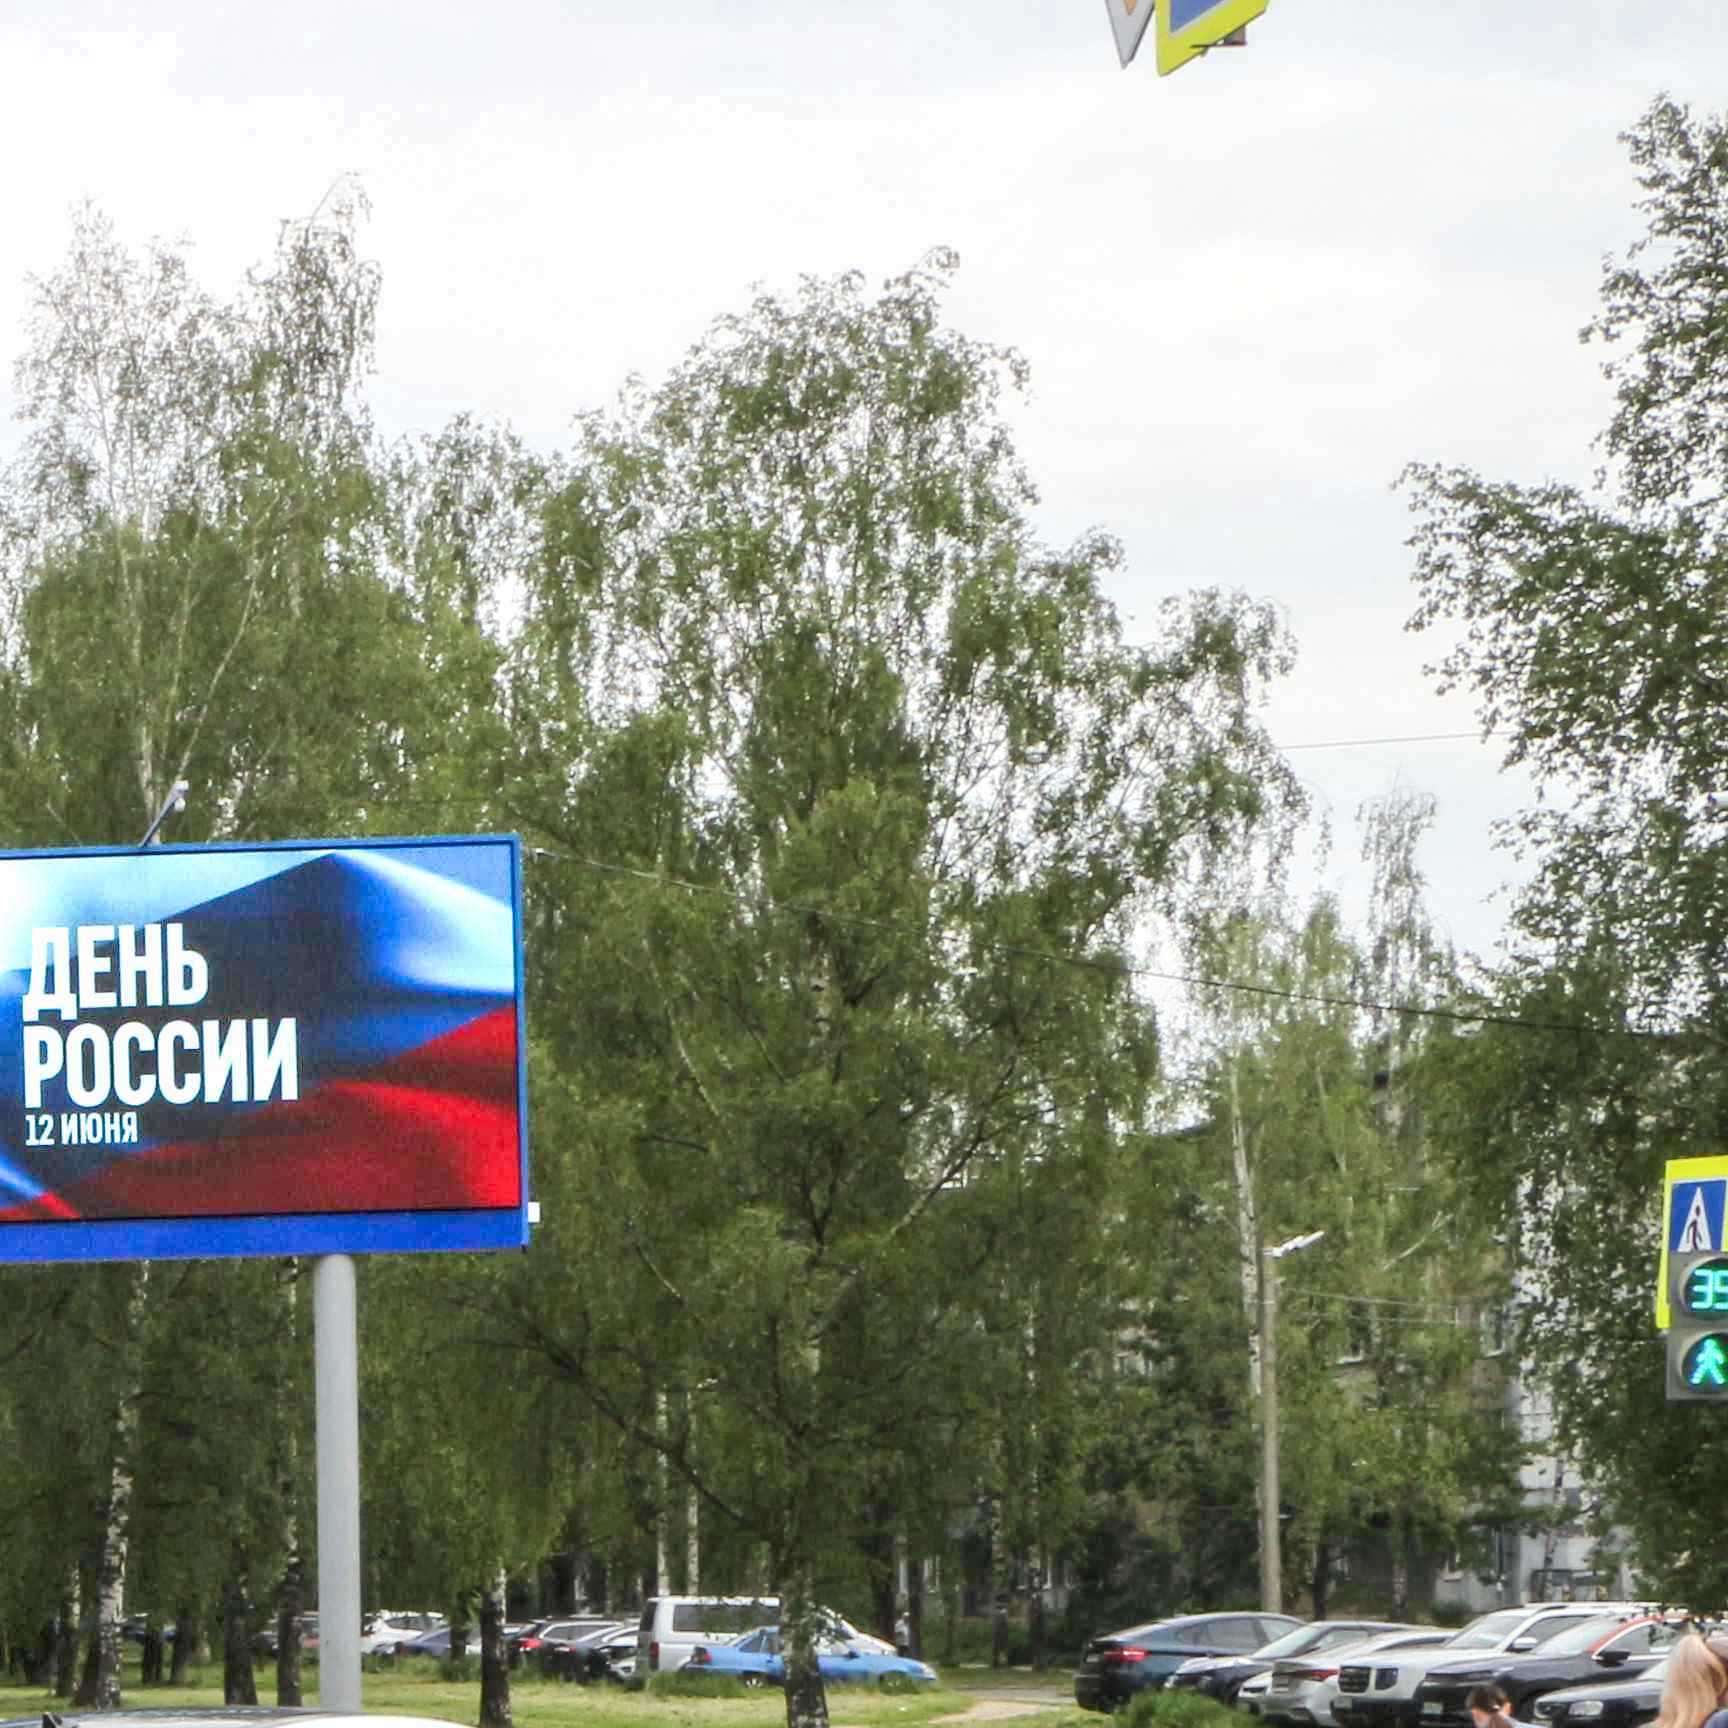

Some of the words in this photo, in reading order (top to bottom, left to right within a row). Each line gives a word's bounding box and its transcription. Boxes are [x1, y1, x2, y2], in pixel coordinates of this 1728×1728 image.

[22, 922, 209, 1022] ДЕНЬ
[22, 1017, 299, 1109] РОССИИ
[25, 1113, 55, 1146] 12
[60, 1111, 139, 1145] ИЮНЯ
